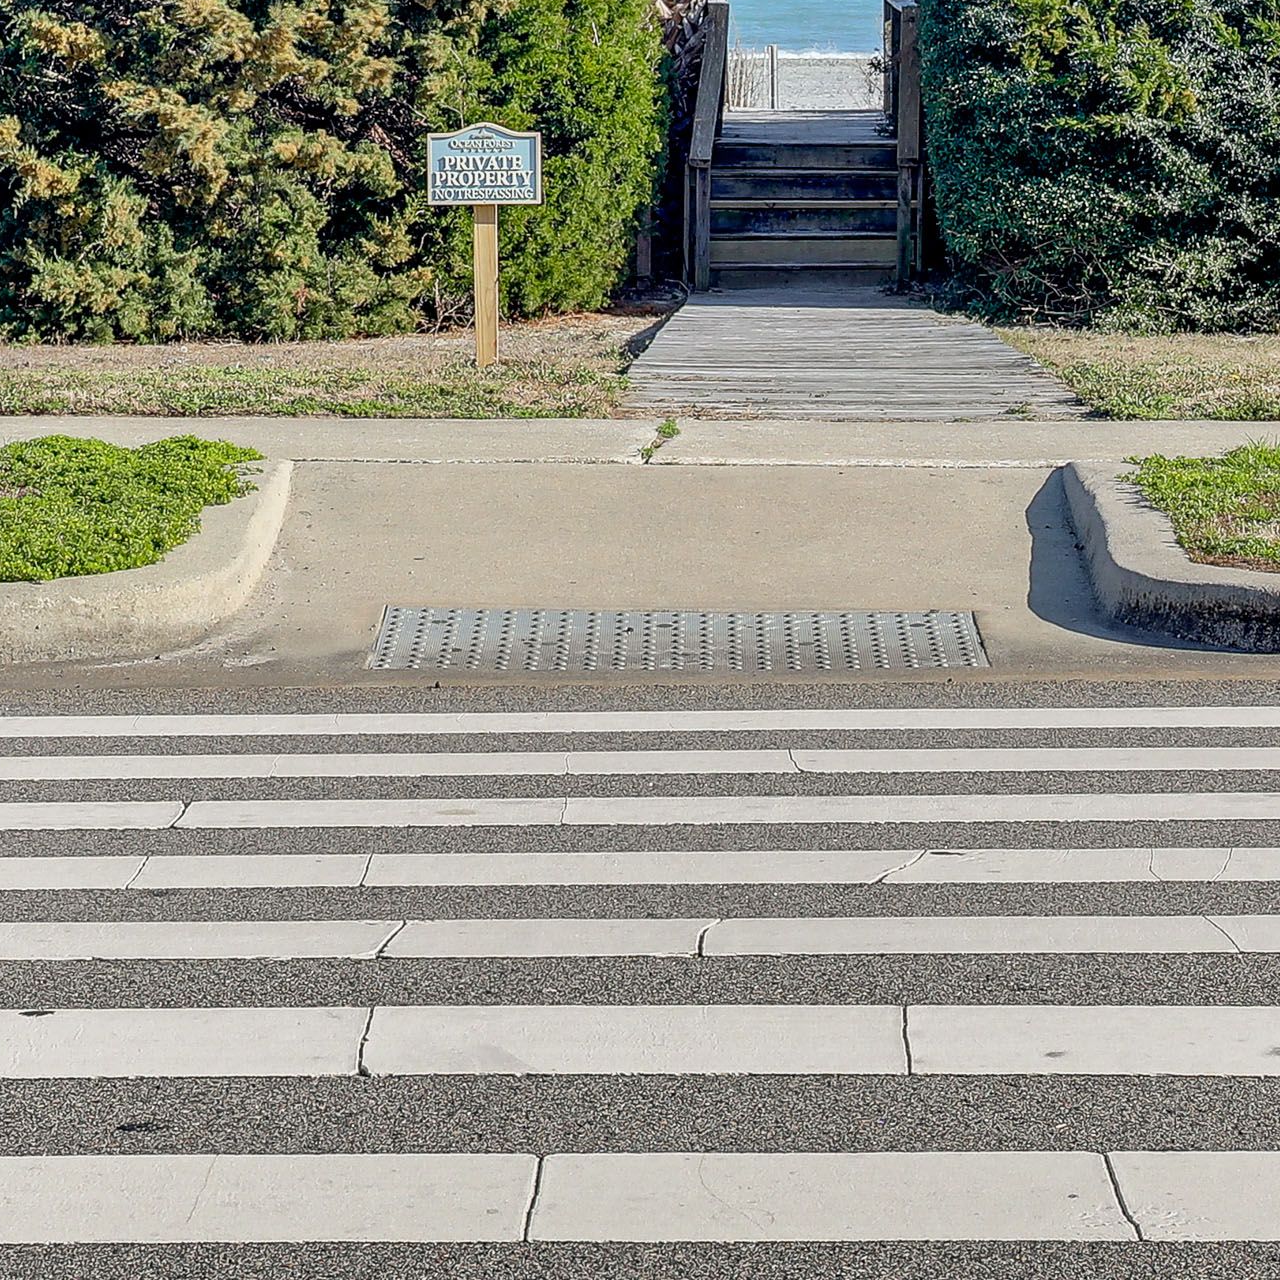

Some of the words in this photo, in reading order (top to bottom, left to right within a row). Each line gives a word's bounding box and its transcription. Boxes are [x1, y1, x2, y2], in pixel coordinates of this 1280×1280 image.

[450, 138, 482, 149] OCEAN
[483, 138, 517, 149] FOREST
[443, 155, 524, 170] PRIVATE
[435, 170, 534, 186] PROPERTY
[435, 187, 455, 199] NO
[455, 187, 534, 199] TRESPASSING
